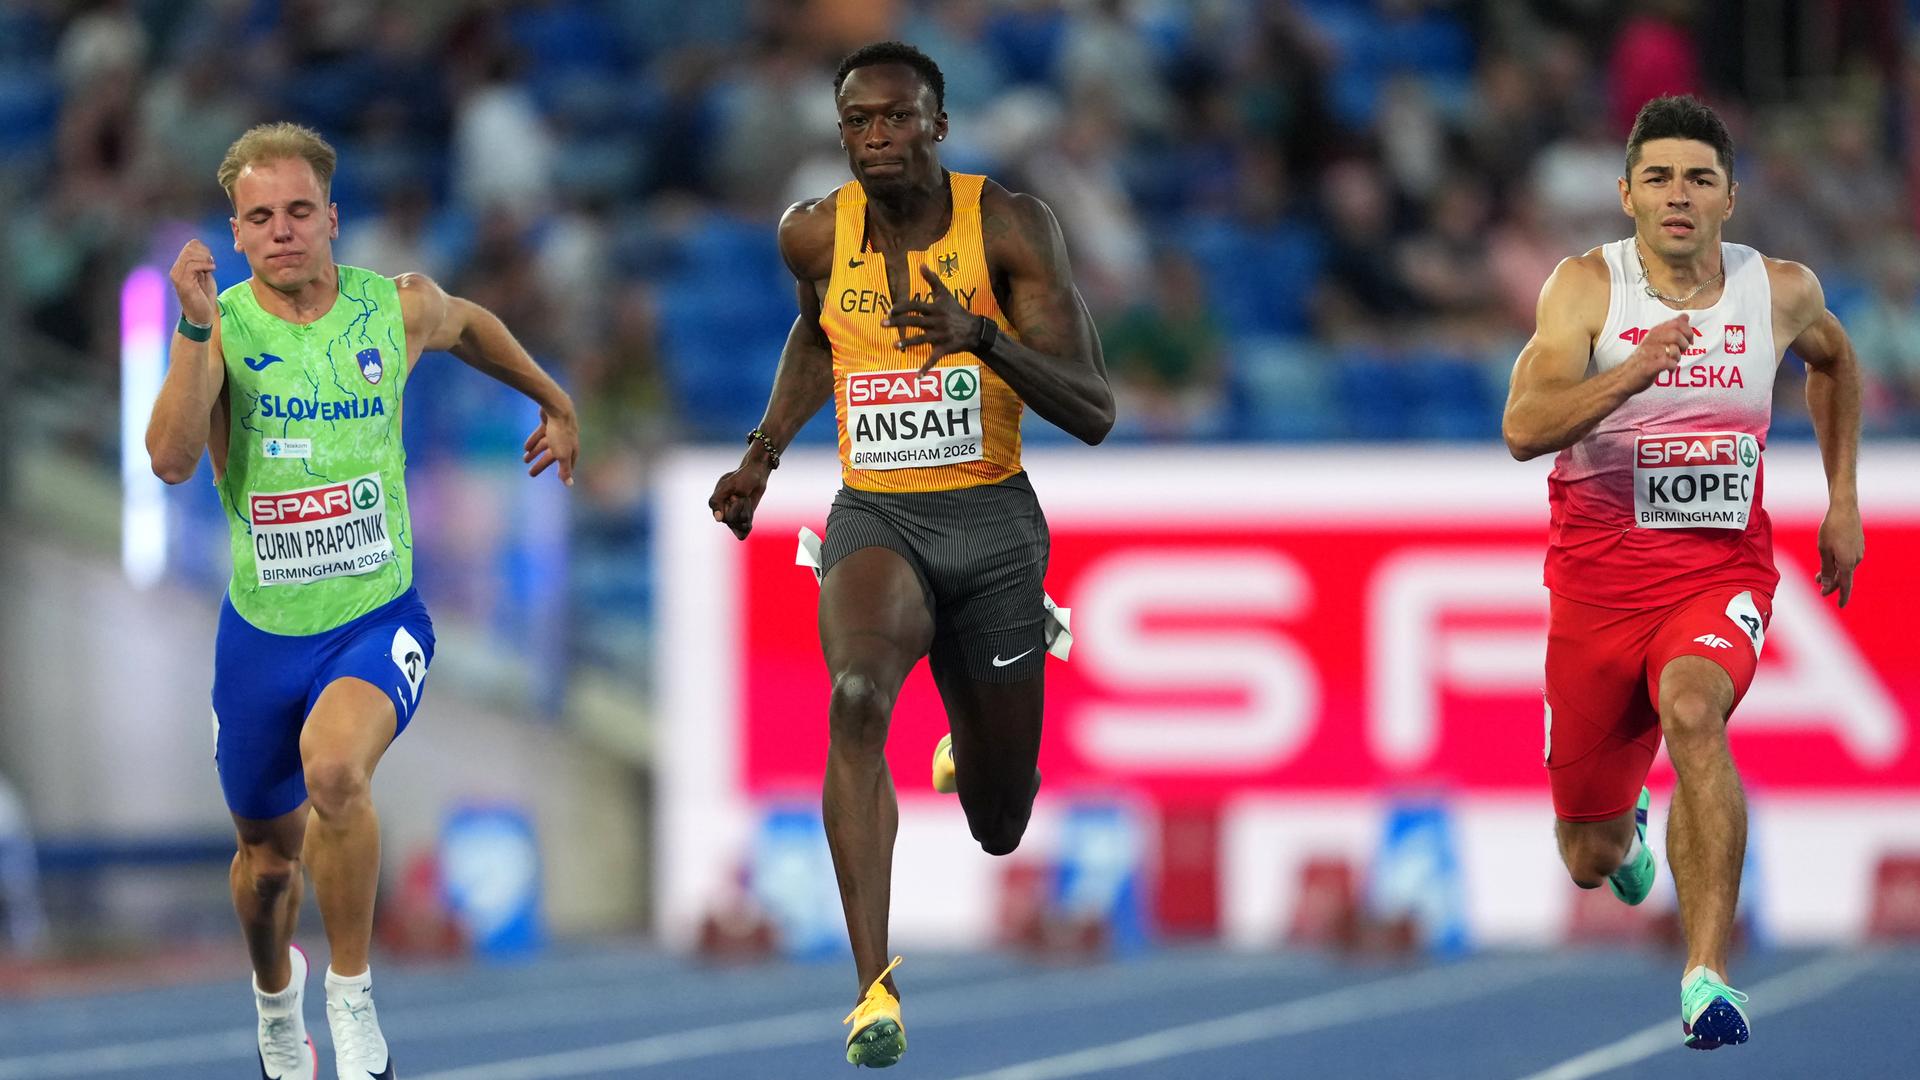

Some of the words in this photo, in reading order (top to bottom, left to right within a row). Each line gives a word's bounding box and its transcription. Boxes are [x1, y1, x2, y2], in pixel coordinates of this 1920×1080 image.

[851, 375, 939, 402] SPAR
[1654, 365, 1744, 388] OLSKA
[260, 393, 385, 421] SLOVENIJA
[856, 407, 970, 442] ANSAH
[855, 448, 940, 464] BIRMINGHAM
[944, 443, 976, 459] 2026
[1640, 439, 1735, 464] SPAR
[1649, 473, 1750, 503] KOPEC
[254, 489, 349, 521] SPAR
[1641, 511, 1734, 523] BIRMINGHAM
[256, 531, 302, 561] CURIN
[306, 513, 386, 557] PRAPOTNIK
[263, 560, 356, 581] BIRMINGHAM
[358, 550, 388, 568] 2026
